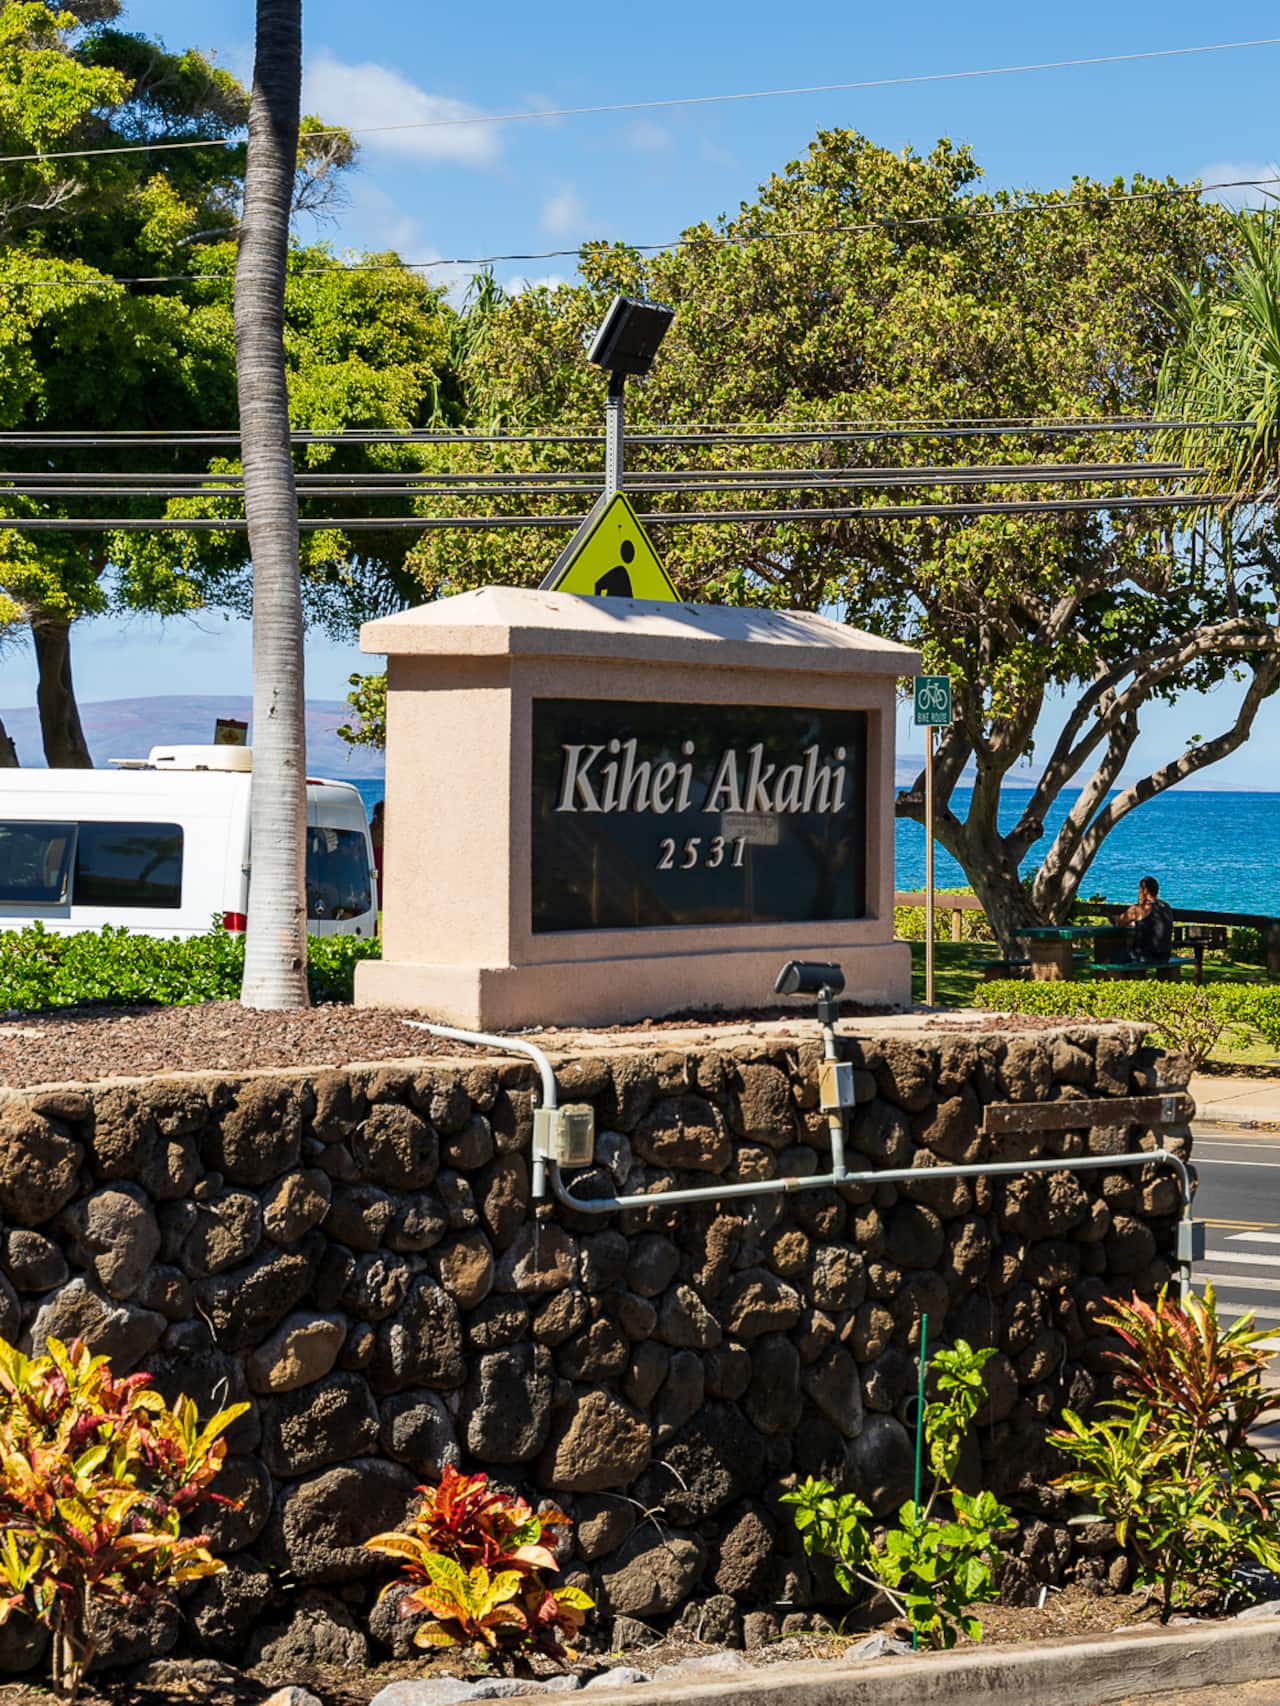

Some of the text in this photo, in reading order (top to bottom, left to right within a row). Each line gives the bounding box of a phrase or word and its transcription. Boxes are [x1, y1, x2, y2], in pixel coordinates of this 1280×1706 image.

[555, 738, 847, 815] Kihei Akahi
[656, 836, 747, 870] 2531
